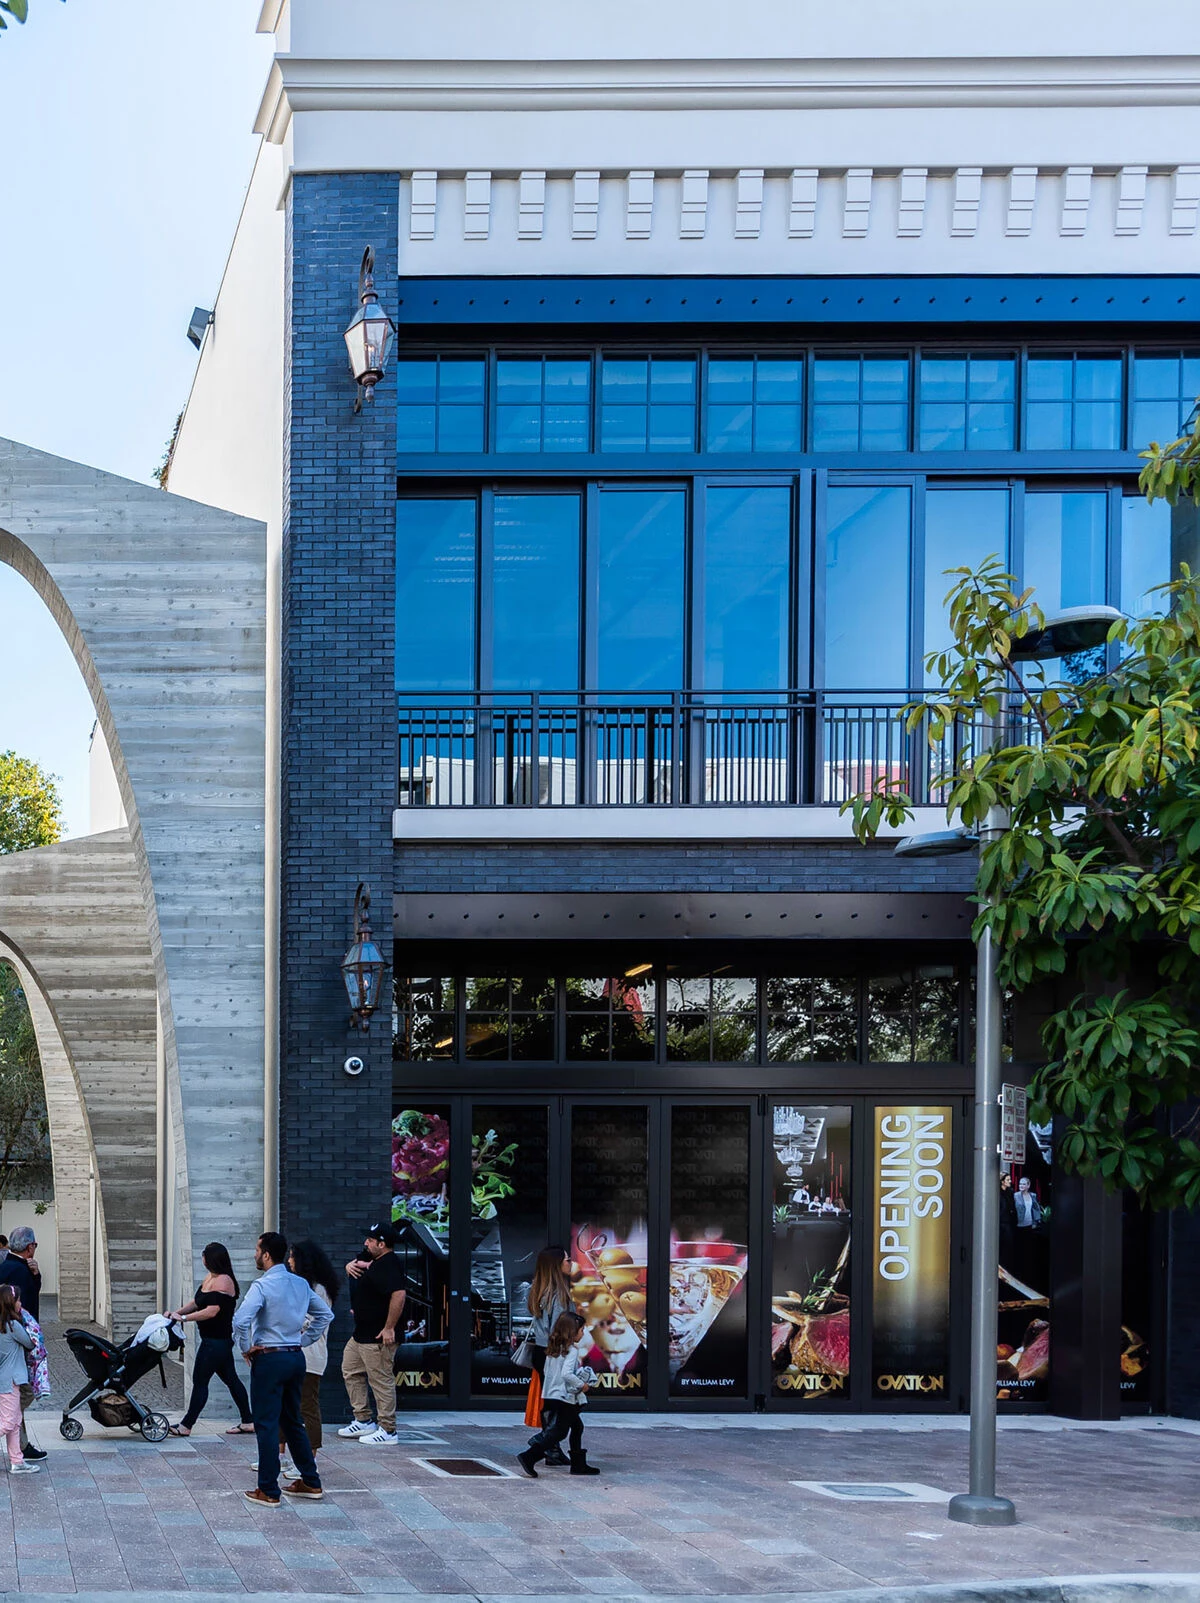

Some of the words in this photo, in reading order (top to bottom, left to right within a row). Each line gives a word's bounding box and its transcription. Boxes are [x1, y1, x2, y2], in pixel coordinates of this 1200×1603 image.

[913, 1114, 945, 1219] SOON
[879, 1114, 912, 1281] OPENING
[490, 1377, 518, 1385] WILLIAM
[681, 1378, 690, 1386] BY
[690, 1378, 718, 1386] WILLIAM
[719, 1378, 735, 1386] LEVY
[777, 1374, 844, 1391] OVATION
[877, 1374, 944, 1392] OVATION
